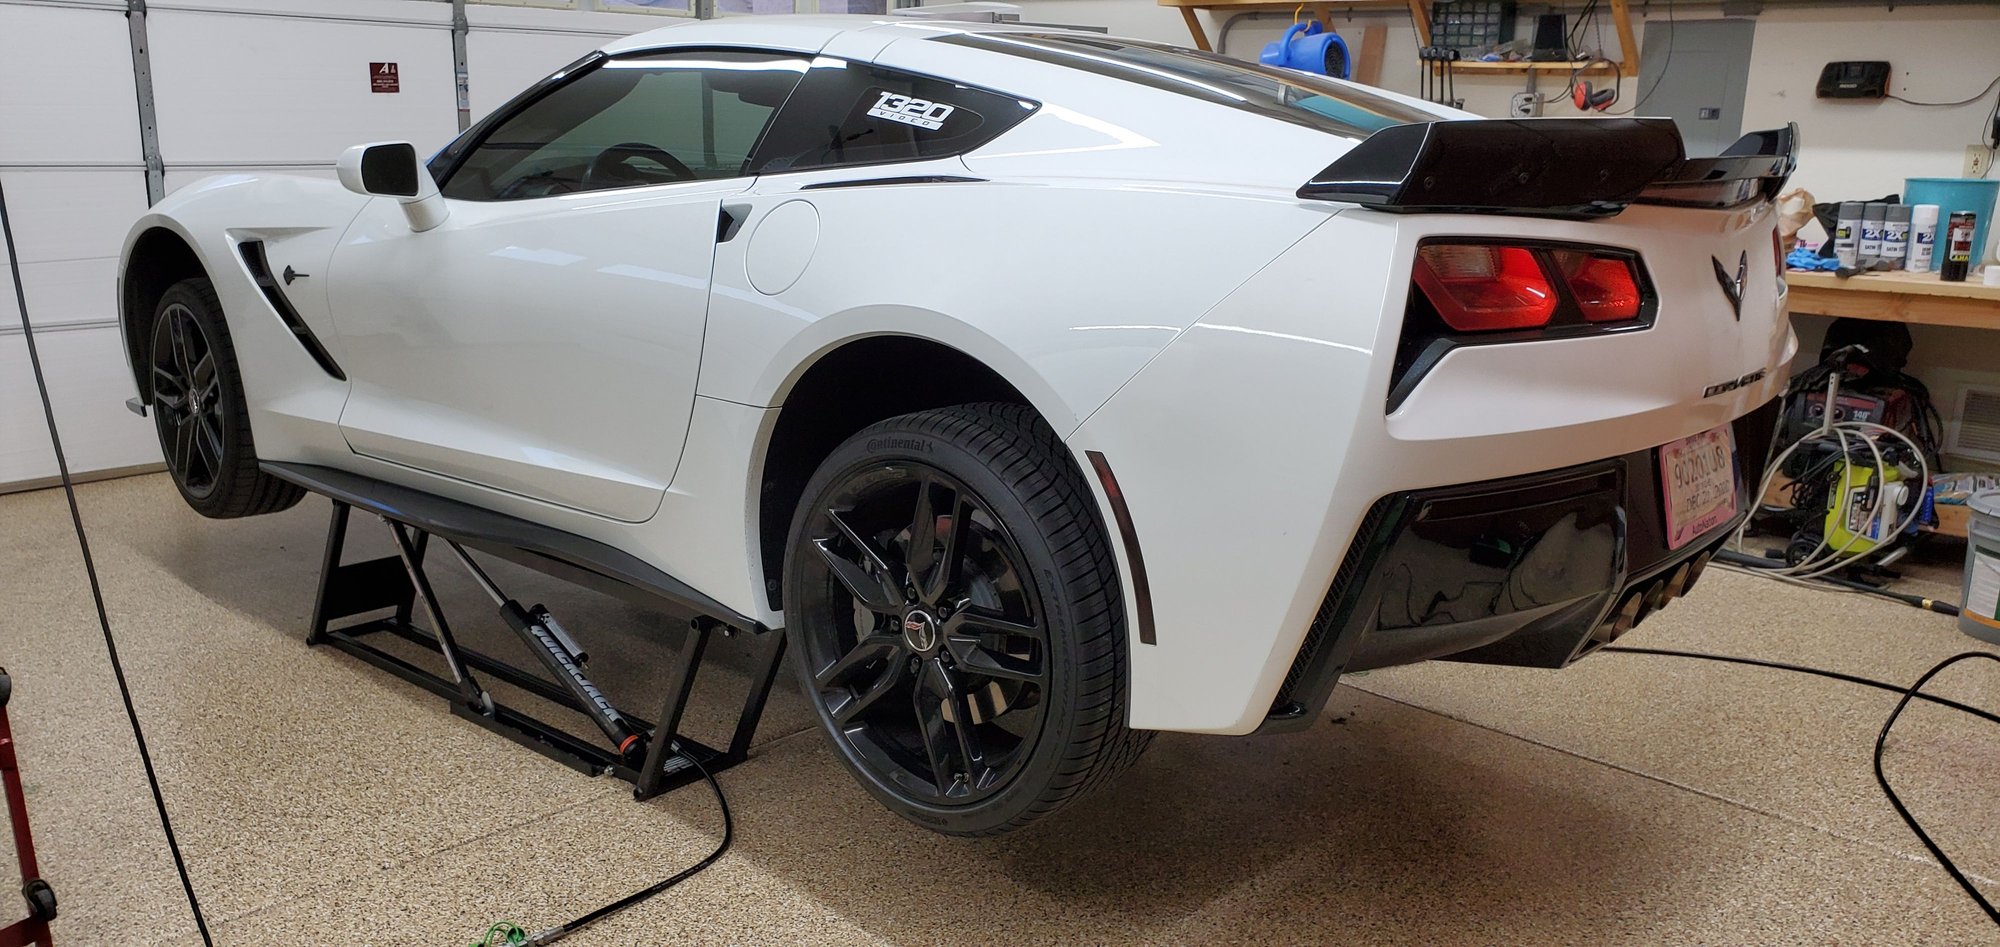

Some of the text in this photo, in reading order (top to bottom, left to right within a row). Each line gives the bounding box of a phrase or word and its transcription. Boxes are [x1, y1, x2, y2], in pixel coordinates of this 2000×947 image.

[873, 91, 955, 122] 1320
[879, 111, 930, 126] VIDEO
[1864, 228, 1881, 238] 2X
[1886, 230, 1903, 240] 2X
[866, 436, 926, 455] Continental
